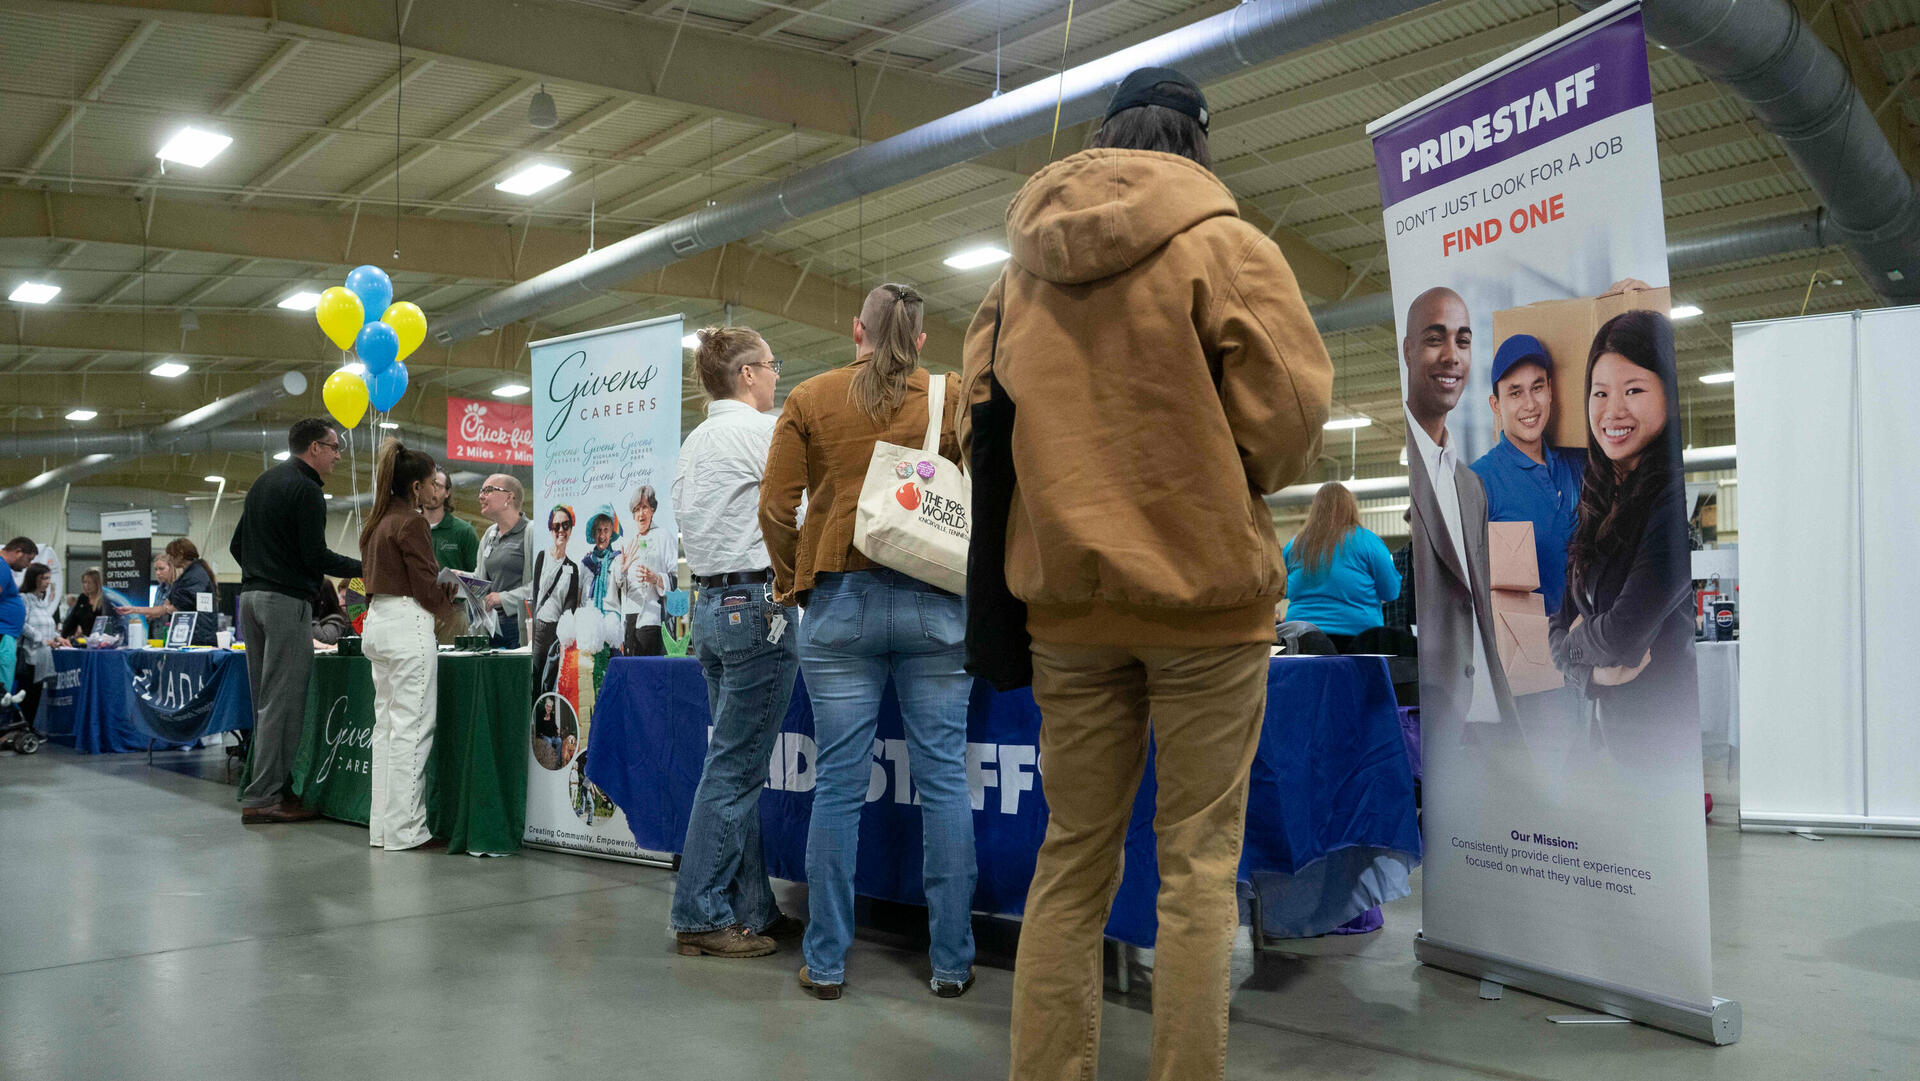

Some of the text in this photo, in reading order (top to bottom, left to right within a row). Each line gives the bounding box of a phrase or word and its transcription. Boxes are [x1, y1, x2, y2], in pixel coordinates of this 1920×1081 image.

[1396, 136, 1624, 236] DON'T JUST LOOK FOR A JOB
[1442, 193, 1565, 257] FIND ONE
[546, 350, 659, 442] Givens
[580, 397, 657, 421] CAREERS
[456, 445, 464, 457] 2
[466, 446, 494, 459] Miles
[505, 449, 512, 461] 7
[582, 437, 617, 467] Givens
[582, 466, 617, 495] Givens
[925, 490, 943, 509] THE
[107, 550, 133, 558] DISCOVER
[117, 560, 136, 568] WORLD
[528, 826, 555, 838] Creating
[596, 835, 640, 850] Empowering
[1510, 830, 1578, 850] Our Mission:
[1451, 836, 1652, 881] Consistently provide client experiences
[1465, 854, 1637, 896] focused on what they value most.
